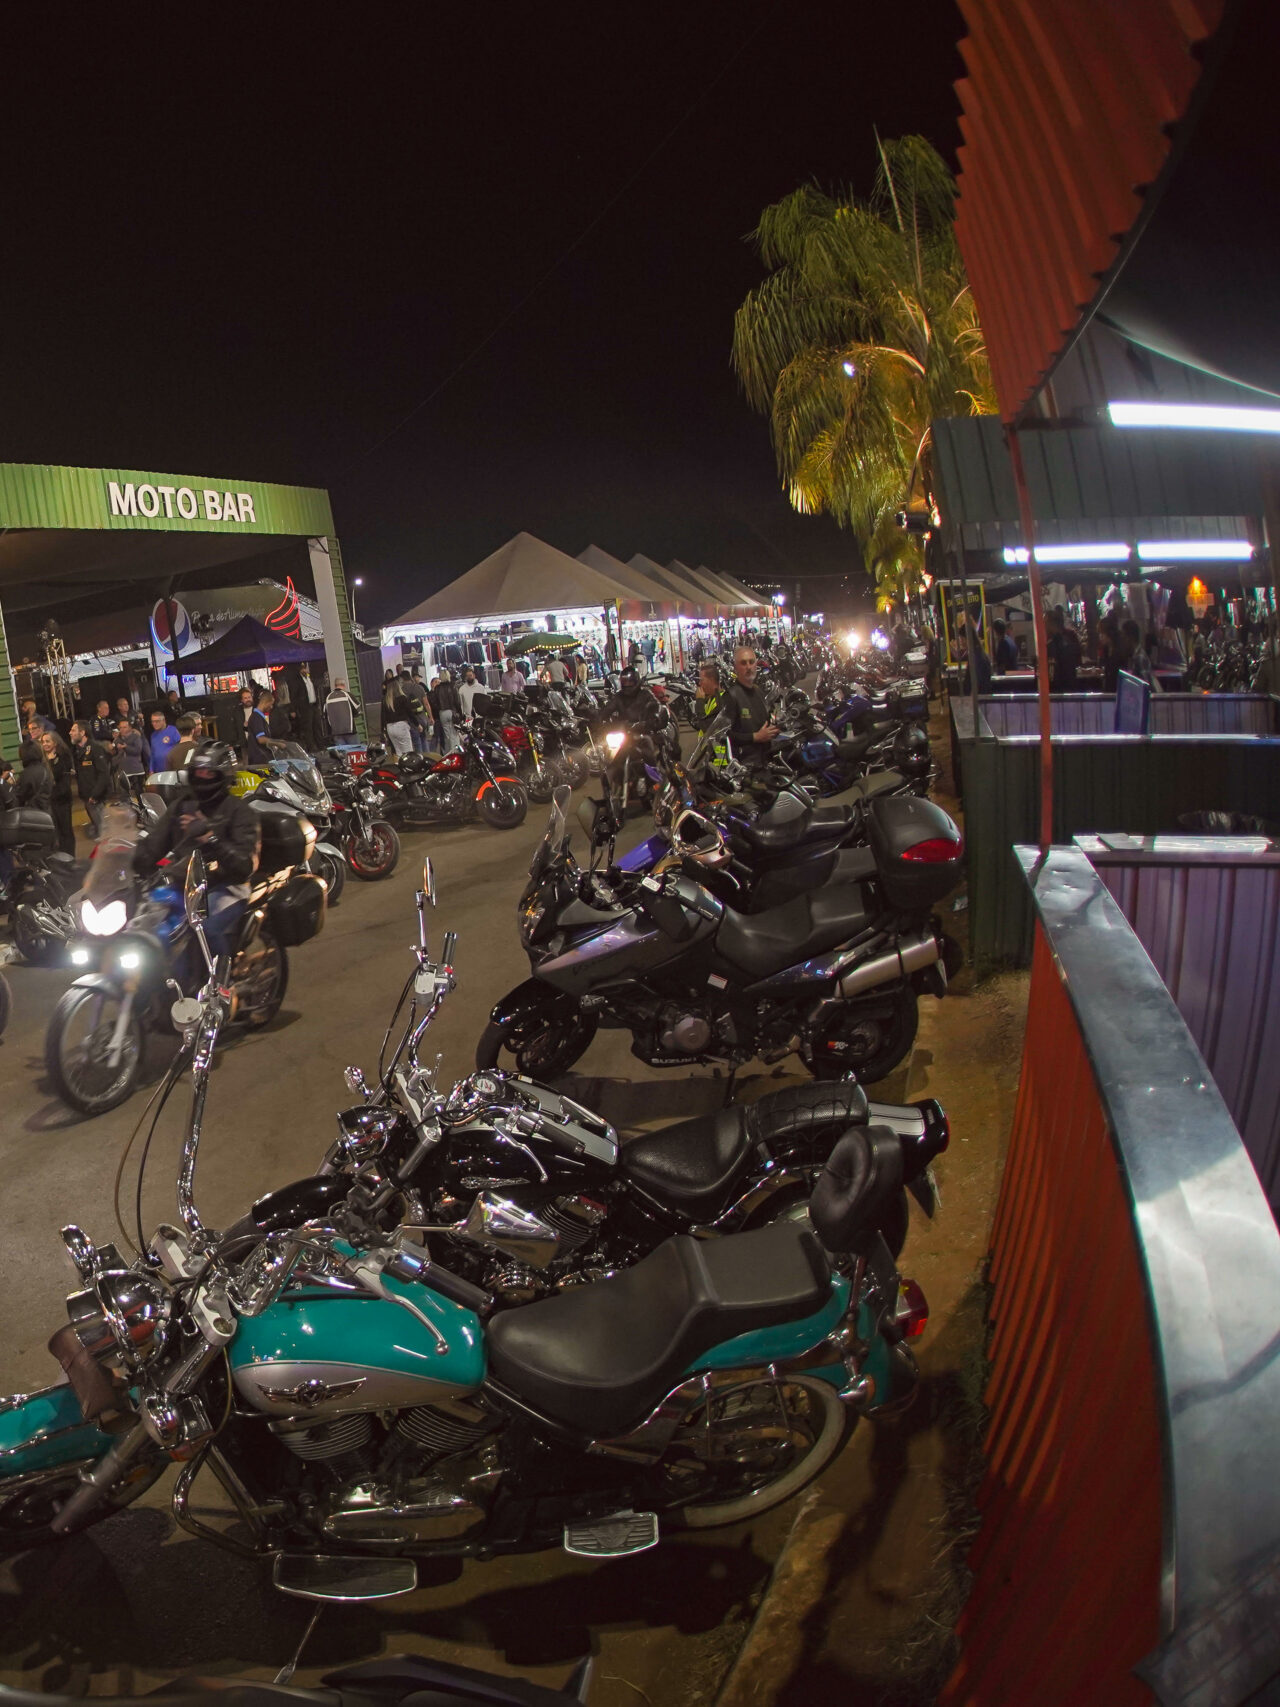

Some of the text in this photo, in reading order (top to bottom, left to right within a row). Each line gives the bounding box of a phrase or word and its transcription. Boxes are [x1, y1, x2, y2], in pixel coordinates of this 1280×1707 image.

[107, 481, 256, 523] MOTO BAR
[651, 1056, 697, 1065] SUZUKI
